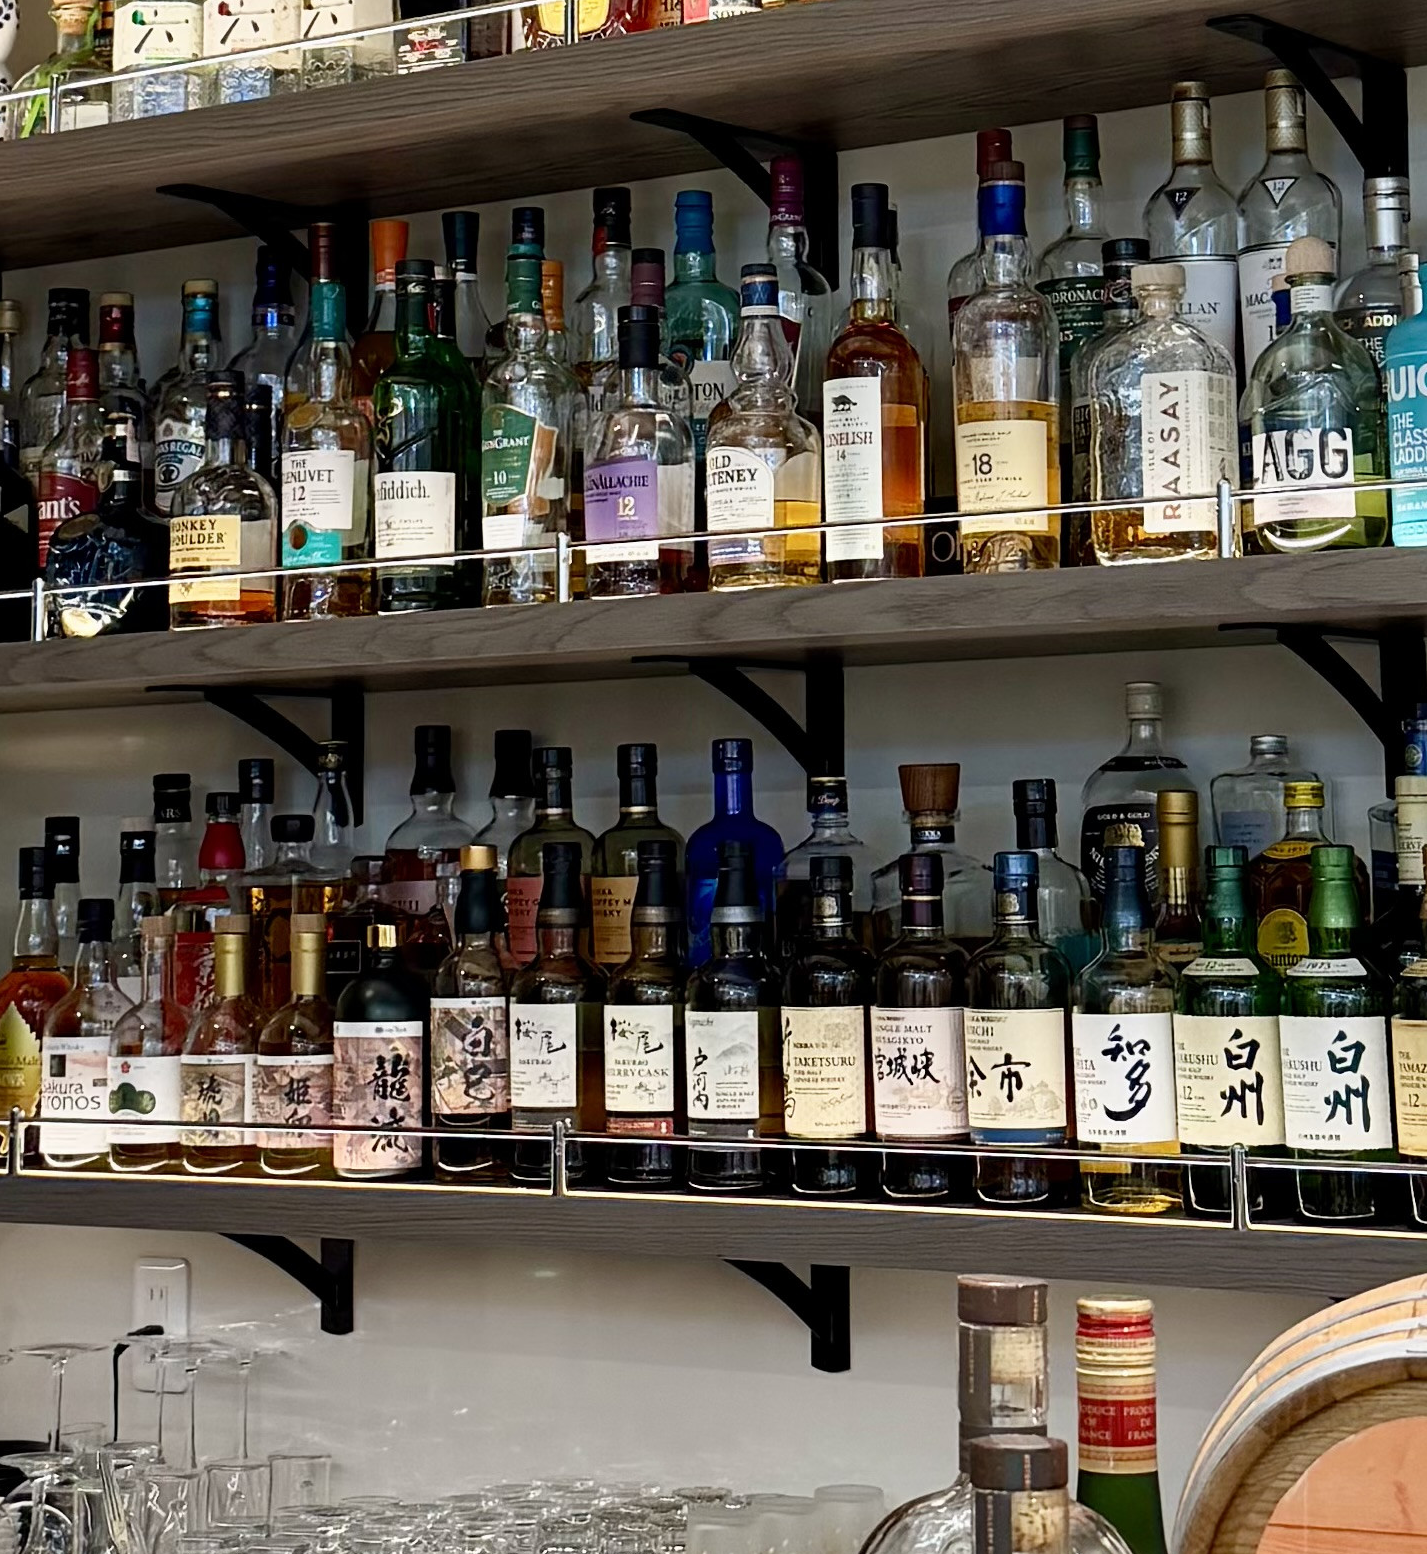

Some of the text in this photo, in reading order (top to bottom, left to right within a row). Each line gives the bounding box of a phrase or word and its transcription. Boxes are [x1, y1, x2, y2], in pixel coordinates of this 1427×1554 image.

[1392, 412, 1414, 428] THE
[835, 448, 847, 462] 14
[1159, 380, 1182, 521] RAASAY
[290, 459, 308, 470] THE
[709, 455, 732, 469] OLD
[971, 453, 993, 476] 18
[492, 470, 508, 485] 10
[292, 486, 306, 501] 12
[617, 496, 636, 517] 12
[1203, 960, 1218, 970] 12
[904, 1024, 933, 1034] MALT
[793, 1056, 857, 1068] TAKETSURU
[637, 1067, 670, 1078] CASK
[1101, 1023, 1152, 1122] 知多
[1220, 1028, 1265, 1126] 白州
[1323, 1029, 1371, 1133] 白州
[1181, 1085, 1193, 1101] 12
[1408, 1093, 1420, 1108] 12
